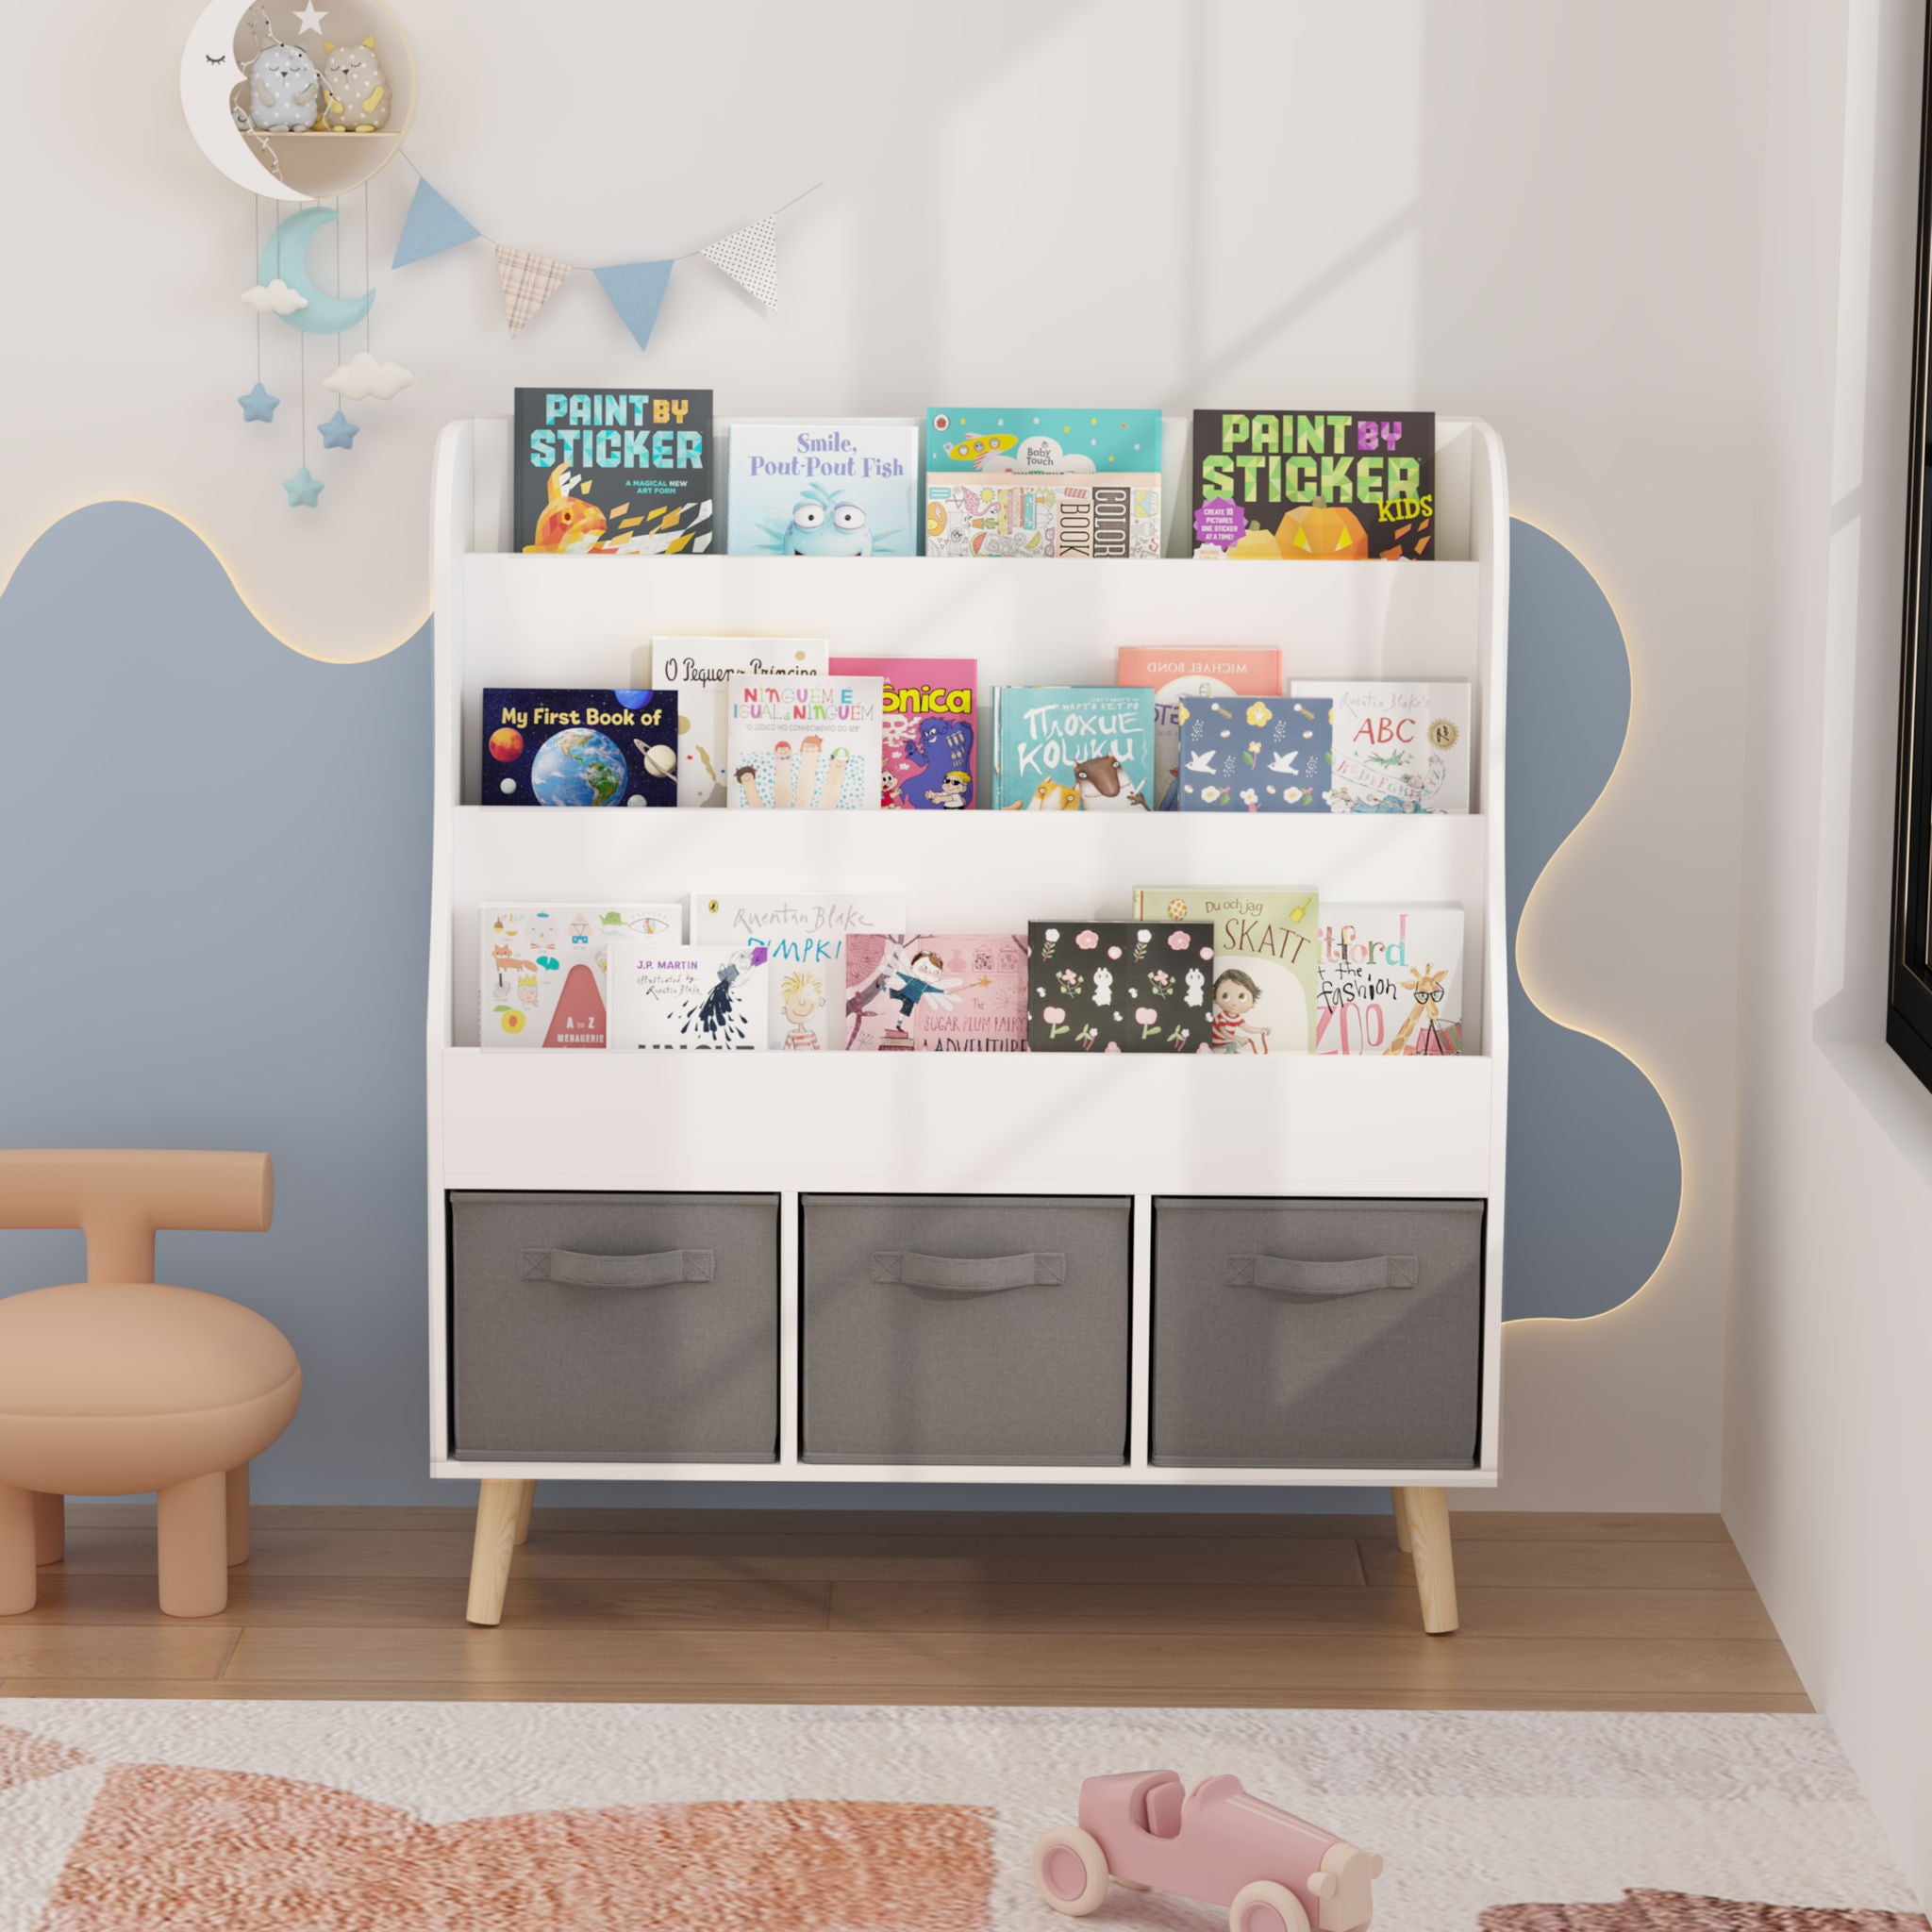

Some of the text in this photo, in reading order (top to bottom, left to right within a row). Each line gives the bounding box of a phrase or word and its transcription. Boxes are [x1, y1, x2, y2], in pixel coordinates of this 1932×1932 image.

[545, 393, 689, 426] PAINT BY
[797, 431, 858, 455] Smile,
[1222, 414, 1403, 454] PAINT BY
[530, 429, 704, 469] STICKER
[1026, 447, 1051, 458] Baby
[748, 456, 906, 478] Pout-Pout Fish
[1026, 457, 1054, 466] Touch
[625, 479, 632, 488] A
[1202, 455, 1421, 504] STICKER
[1204, 508, 1225, 516] CREATE
[1376, 494, 1434, 523] KIDS
[1059, 503, 1091, 558] BOOK
[1094, 489, 1127, 558] COLOR
[665, 658, 678, 682] O
[501, 708, 663, 729] My First Book of
[1352, 717, 1416, 745] ABC
[805, 904, 875, 934] Blake
[1205, 899, 1263, 917] Du och jag
[1223, 918, 1311, 964] SKATT
[637, 960, 699, 970] J.P. MARTIN
[1336, 962, 1362, 980] the
[1317, 974, 1397, 1014] fashion
[566, 1017, 575, 1029] A
[588, 1017, 595, 1029] Z
[924, 1016, 1028, 1033] SUGAR PLUM FAIRY
[1316, 1002, 1385, 1056] ZOO
[557, 1034, 605, 1043] MENAGERIE
